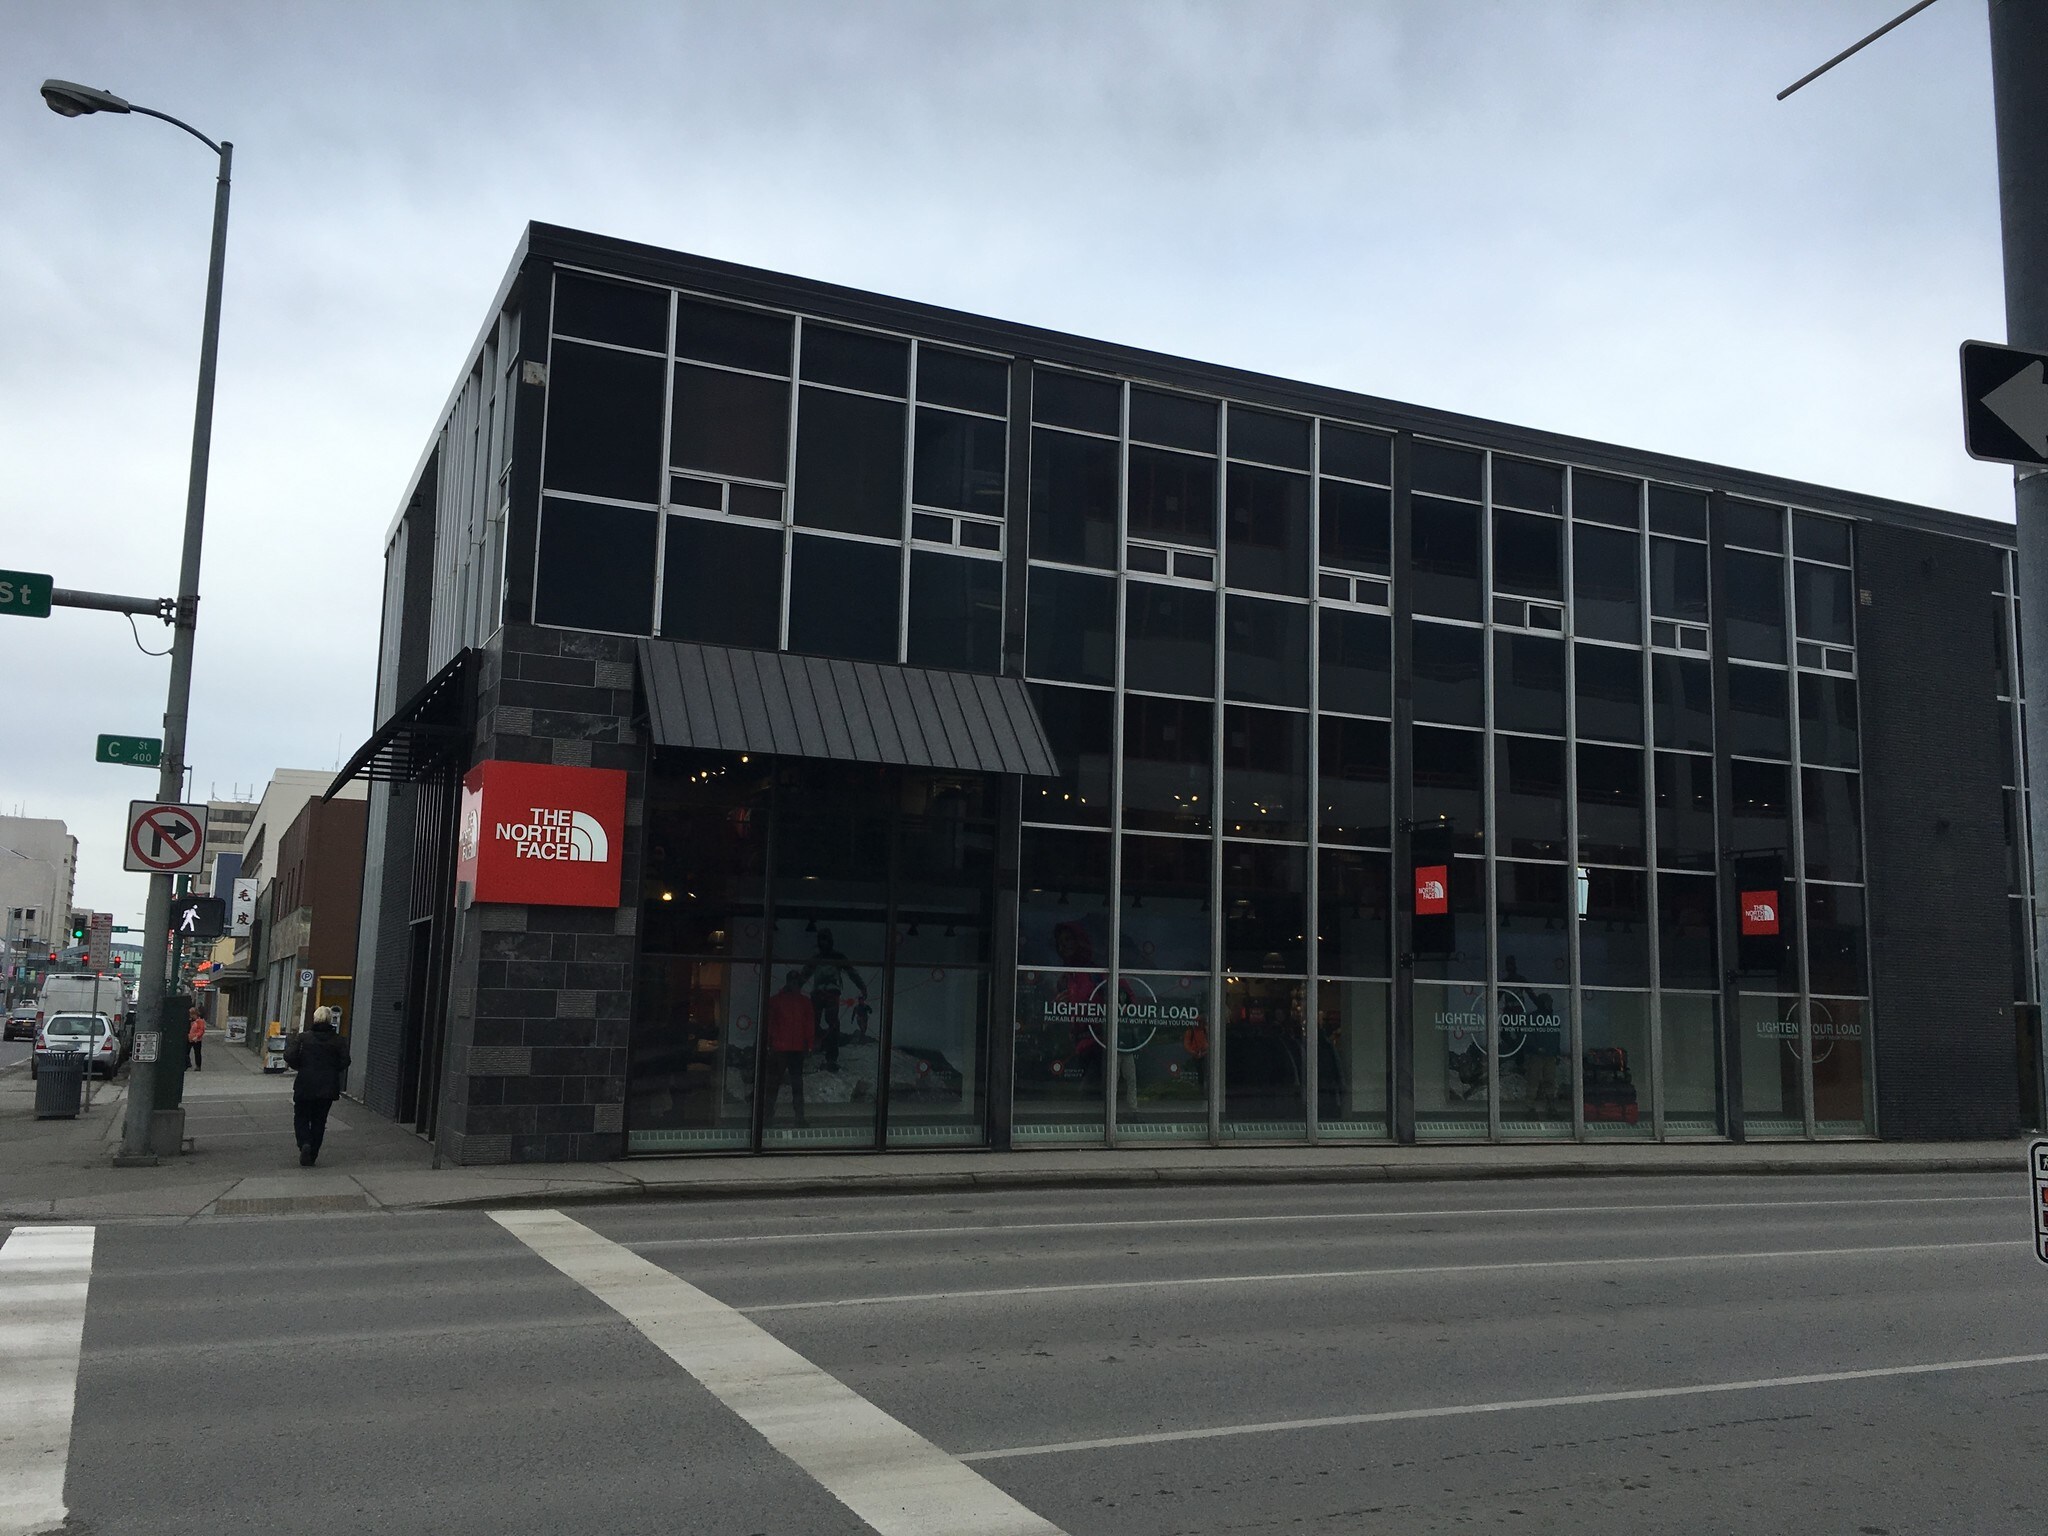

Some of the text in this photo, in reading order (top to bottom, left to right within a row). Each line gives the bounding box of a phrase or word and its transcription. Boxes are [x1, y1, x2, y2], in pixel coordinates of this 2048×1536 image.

[0, 581, 32, 605] St
[108, 741, 148, 757] C St
[132, 752, 152, 762] 400
[530, 807, 572, 827] THE
[495, 822, 570, 844] NORTH
[516, 841, 569, 861] FACE
[1044, 1001, 1199, 1020] LIGHTEN YOUR LOAD
[1044, 1015, 1076, 1023] PACKABLE
[1435, 1012, 1485, 1025] LIGHTEN
[1530, 1014, 1561, 1027] LOAD
[1757, 1022, 1862, 1035] LIGHTEN OUR LOAD
